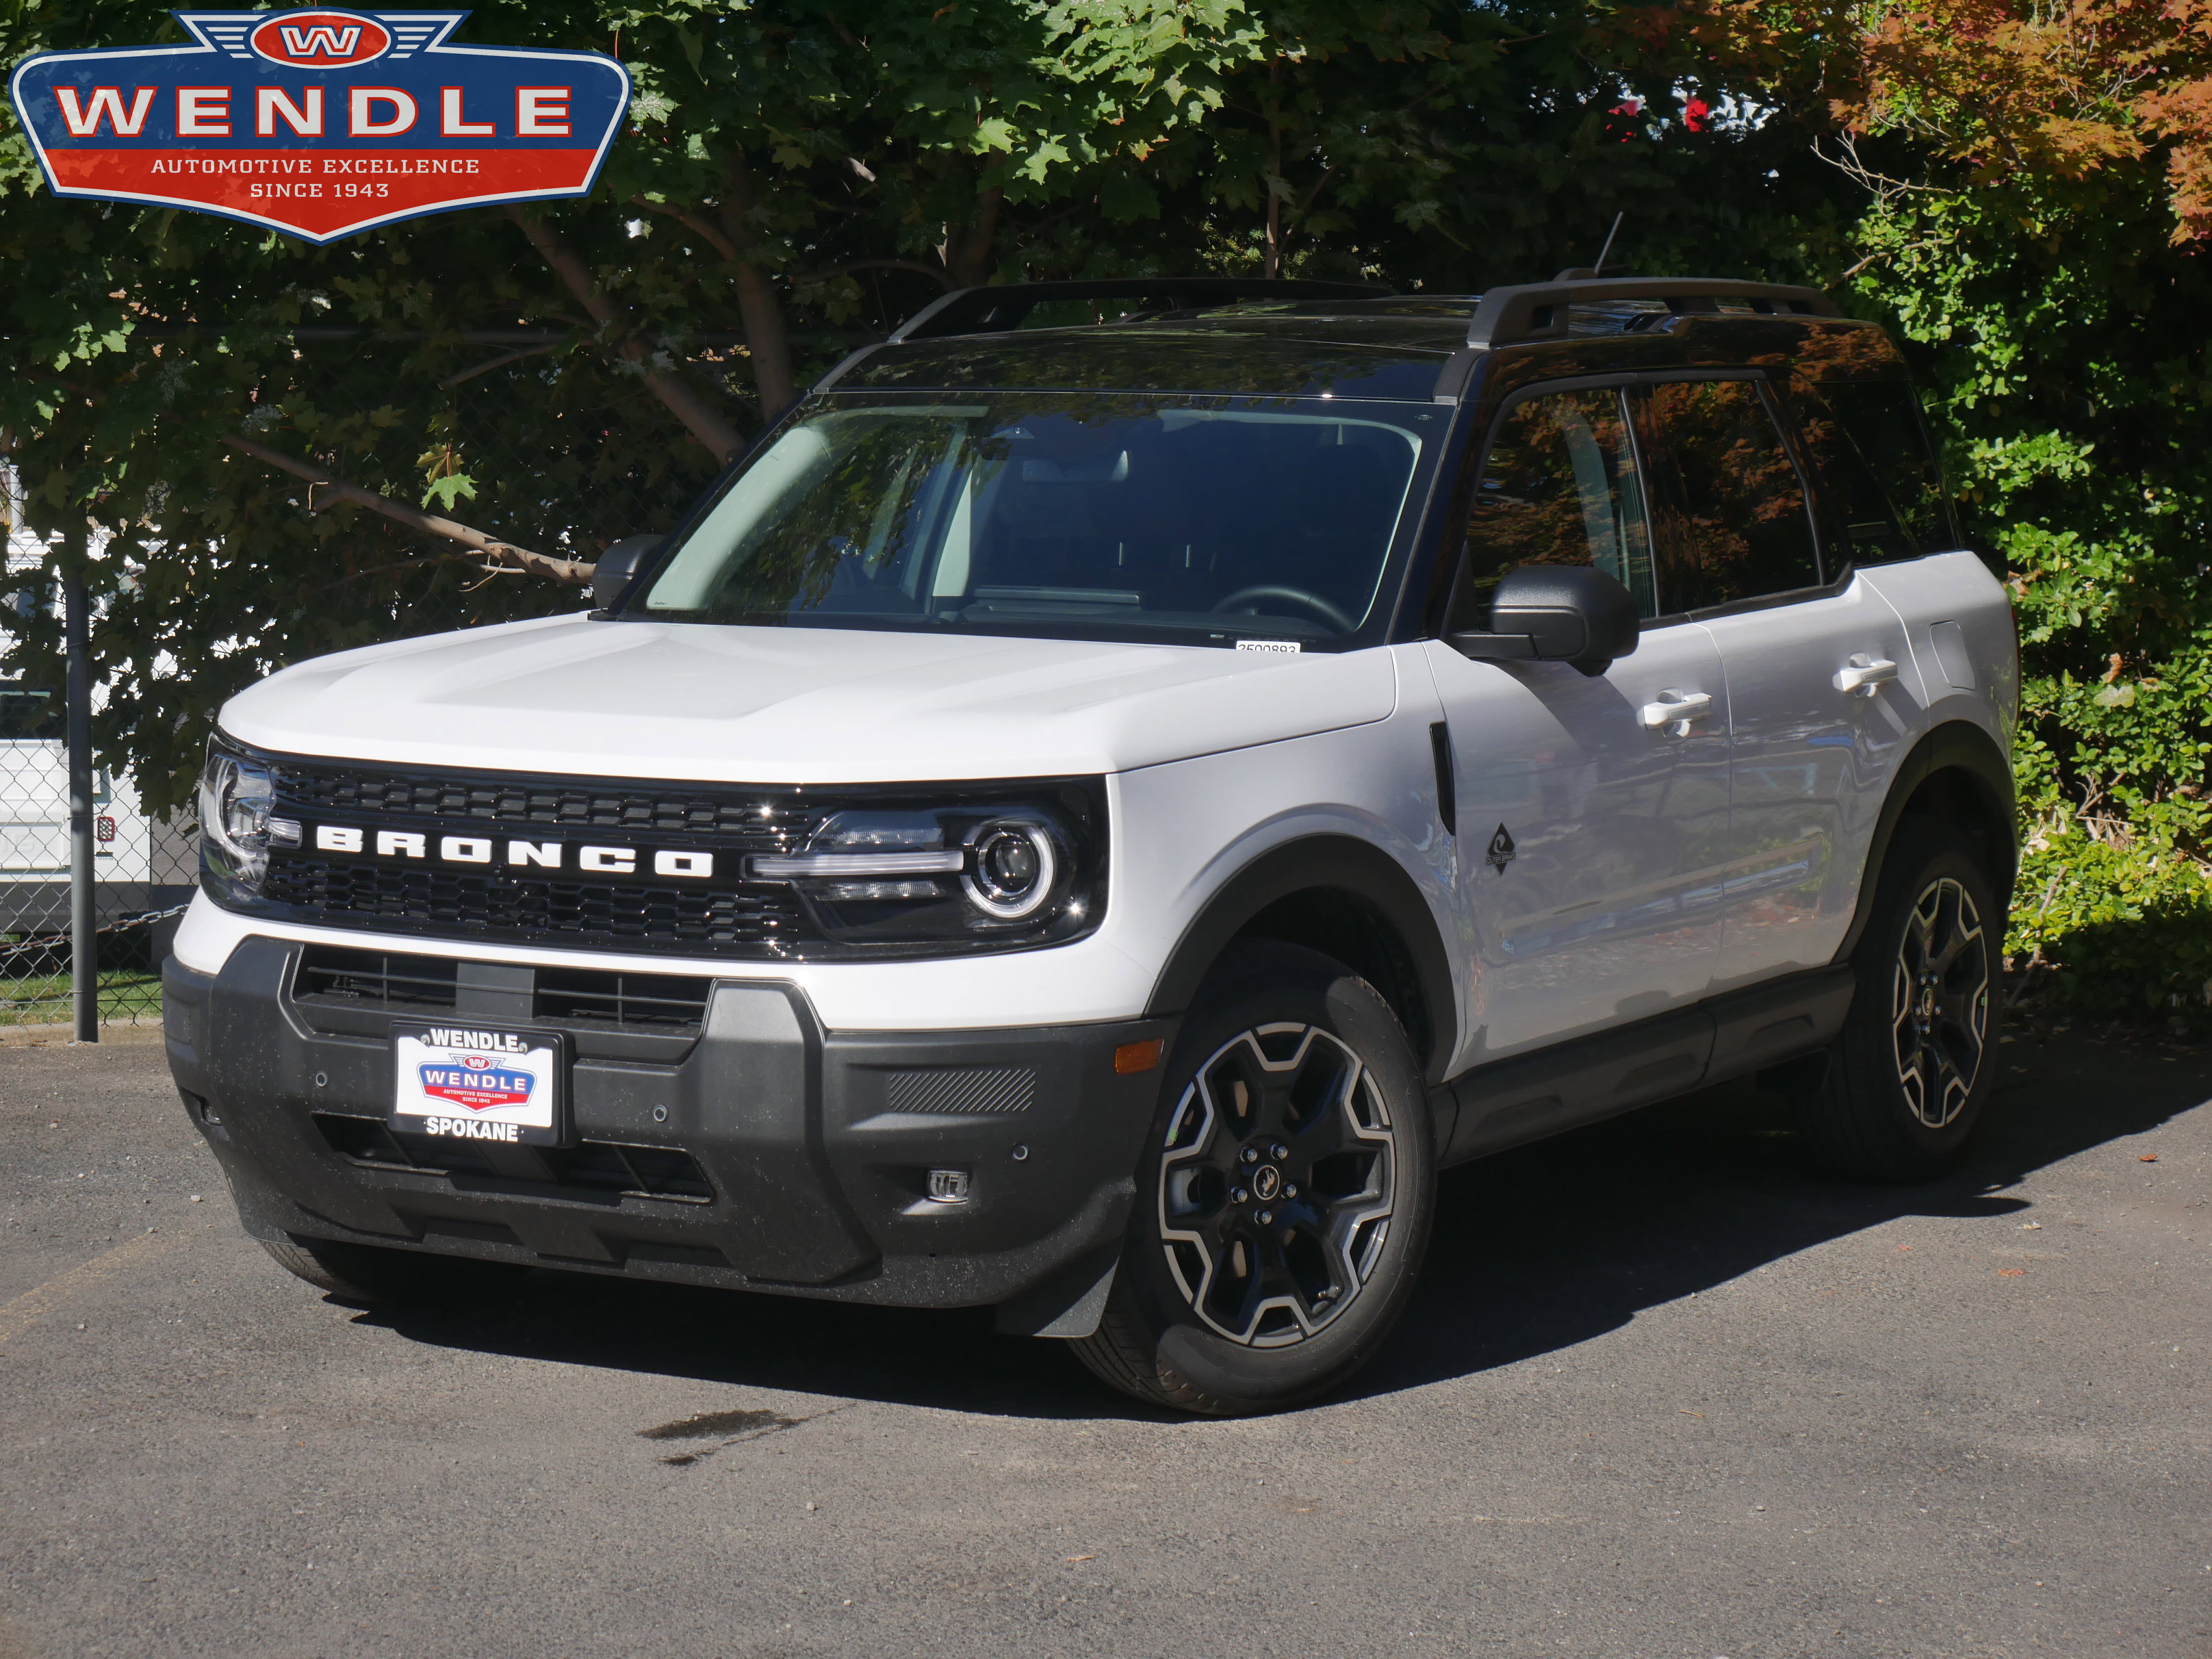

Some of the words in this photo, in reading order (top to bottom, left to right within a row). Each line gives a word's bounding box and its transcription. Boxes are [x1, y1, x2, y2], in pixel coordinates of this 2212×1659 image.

[316, 825, 714, 877] BRONCO
[430, 1029, 519, 1052] WENDLE
[425, 1070, 526, 1091] WENDLE
[426, 1117, 518, 1142] SPOKANE
